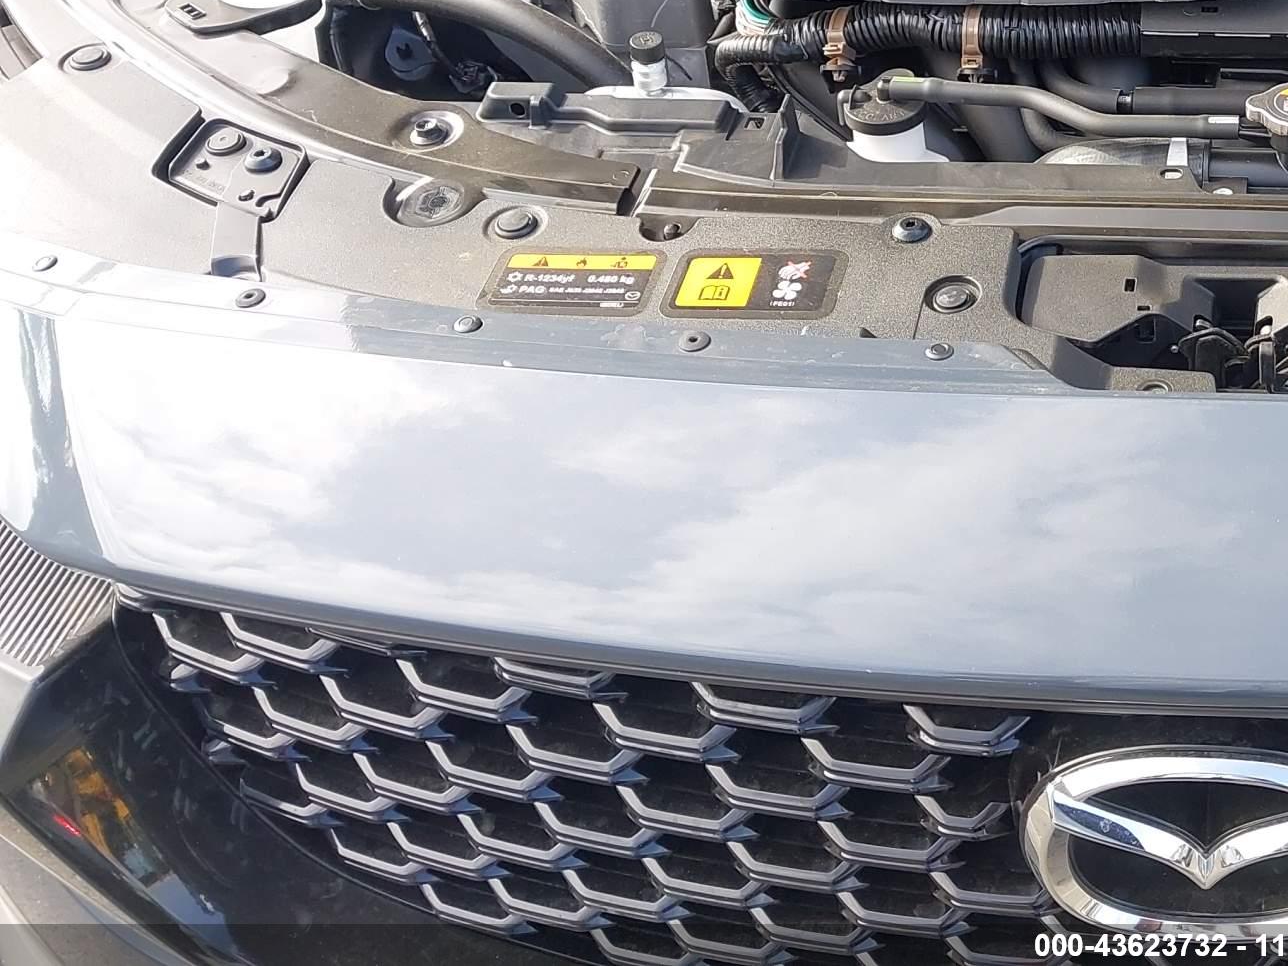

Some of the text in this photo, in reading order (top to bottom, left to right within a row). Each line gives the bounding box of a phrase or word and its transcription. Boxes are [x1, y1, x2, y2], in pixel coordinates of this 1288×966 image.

[523, 273, 575, 284] R-1234yf
[619, 274, 635, 285] kg
[518, 285, 545, 294] PAG
